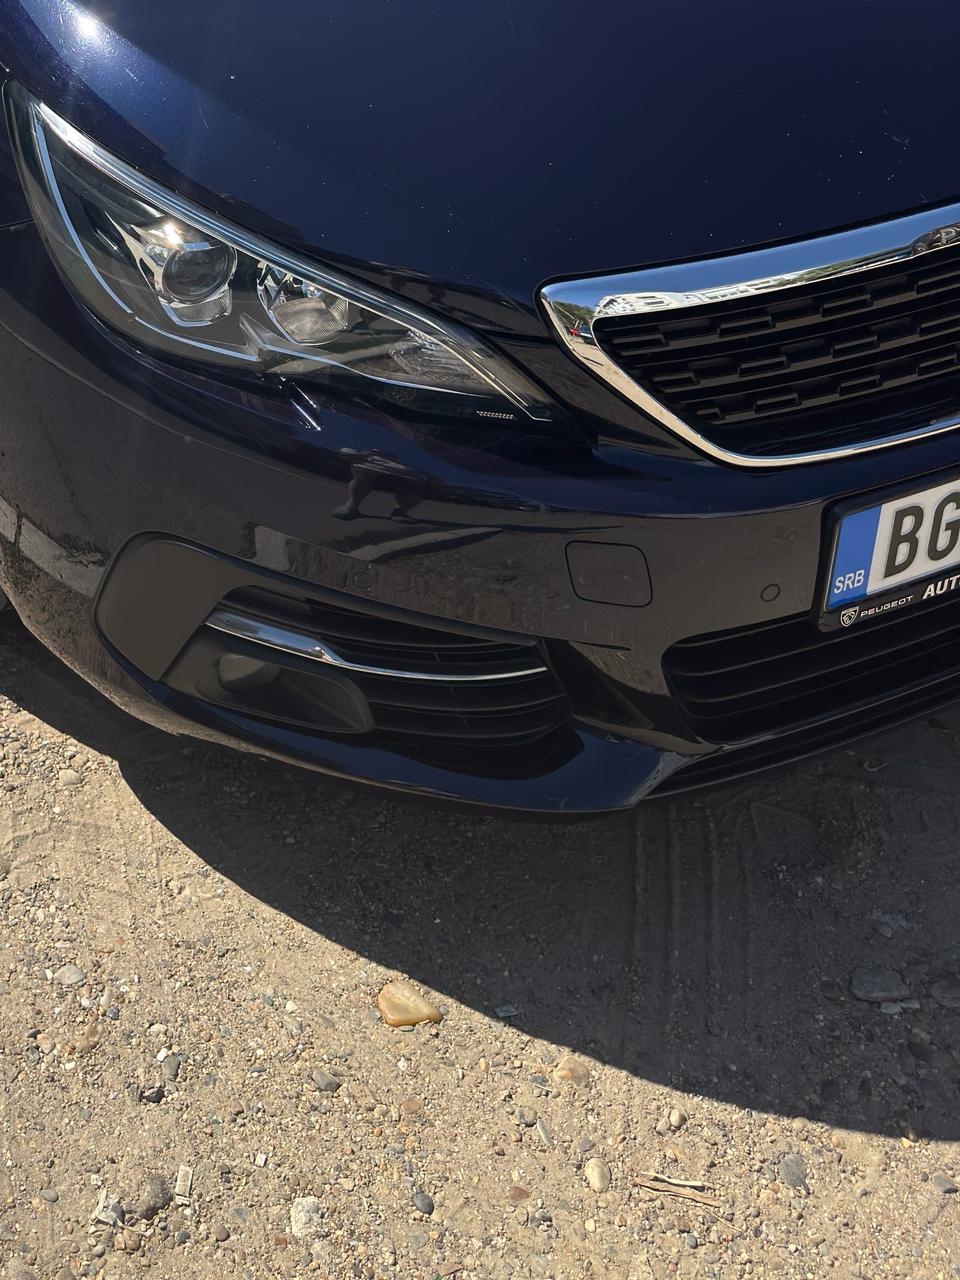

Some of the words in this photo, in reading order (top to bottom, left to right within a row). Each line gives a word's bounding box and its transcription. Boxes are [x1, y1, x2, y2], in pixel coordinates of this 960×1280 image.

[883, 491, 960, 578] BG
[834, 570, 865, 594] SRB
[860, 595, 913, 617] PEUGEOT
[922, 574, 960, 599] AUT
